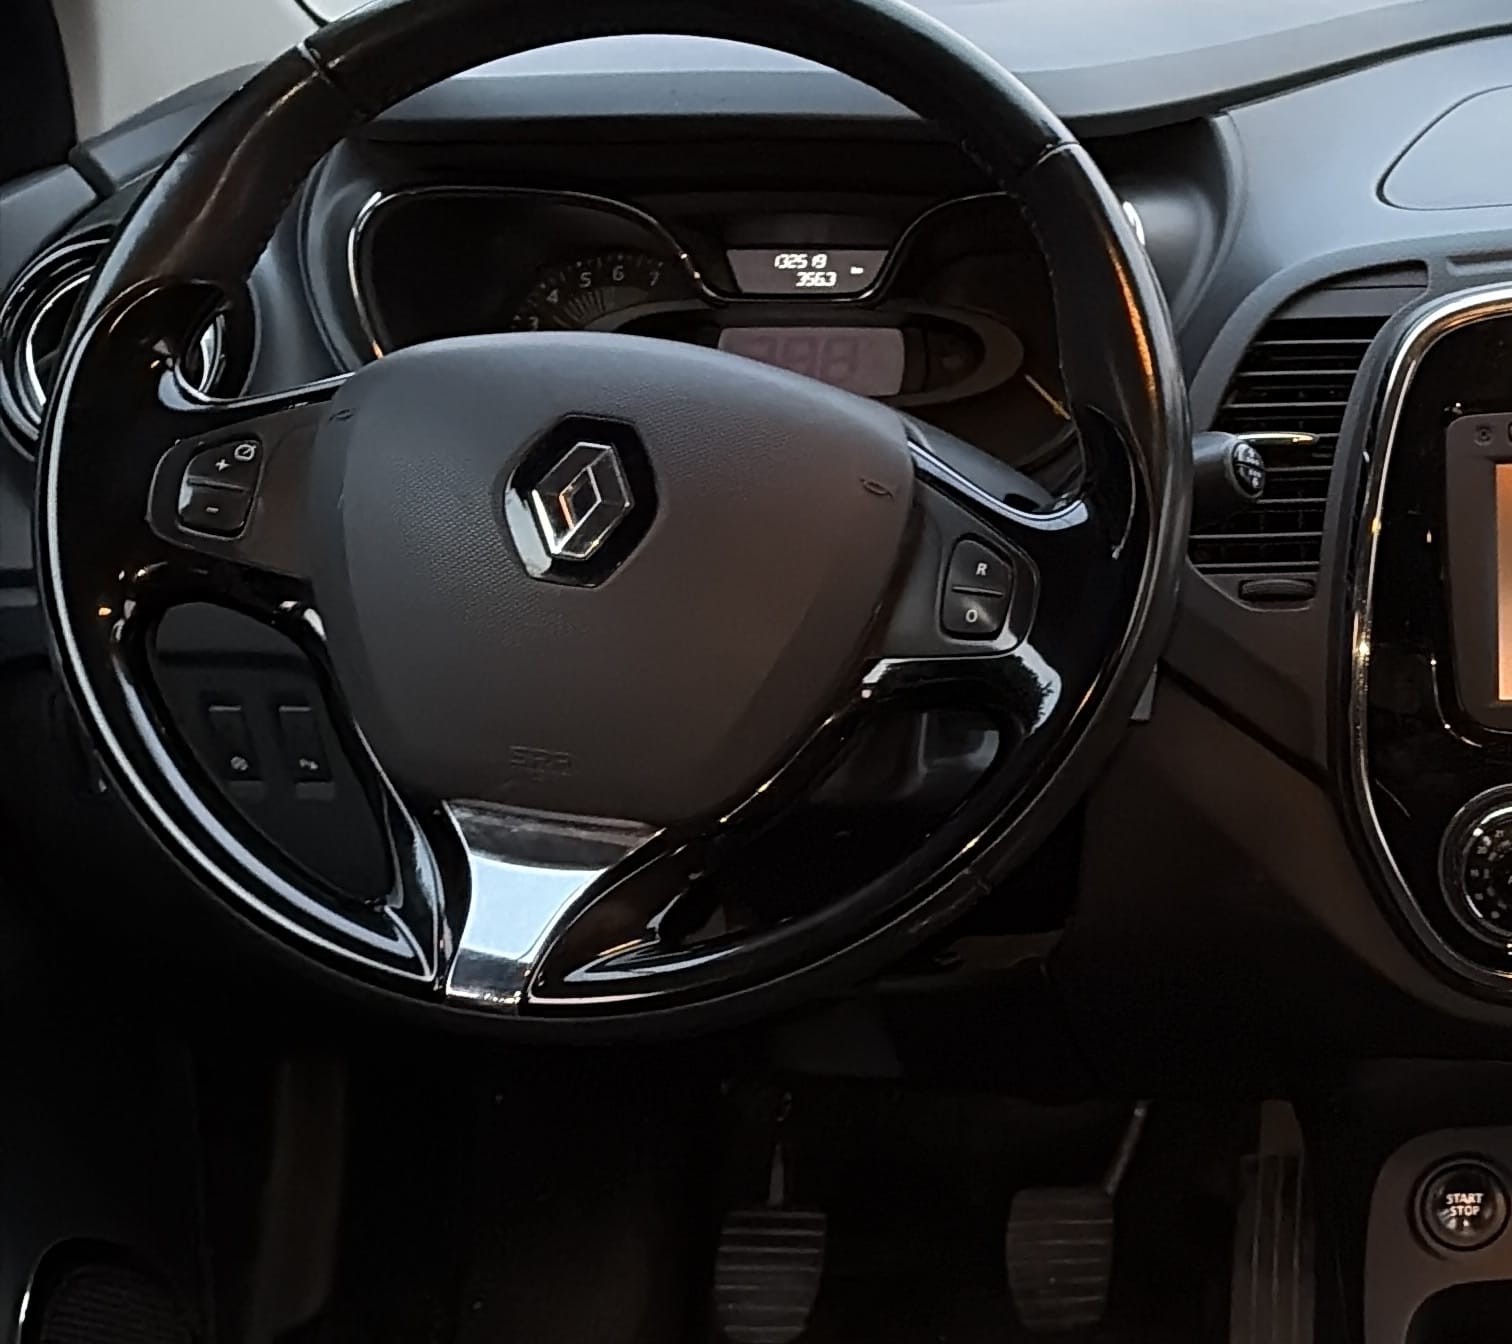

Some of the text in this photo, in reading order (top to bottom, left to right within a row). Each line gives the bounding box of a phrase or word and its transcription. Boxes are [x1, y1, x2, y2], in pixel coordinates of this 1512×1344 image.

[579, 271, 593, 288] 5
[612, 265, 625, 281] 6
[546, 289, 559, 303] 4
[976, 562, 988, 576] R
[1445, 1192, 1484, 1205] START
[1450, 1205, 1480, 1217] STOP
